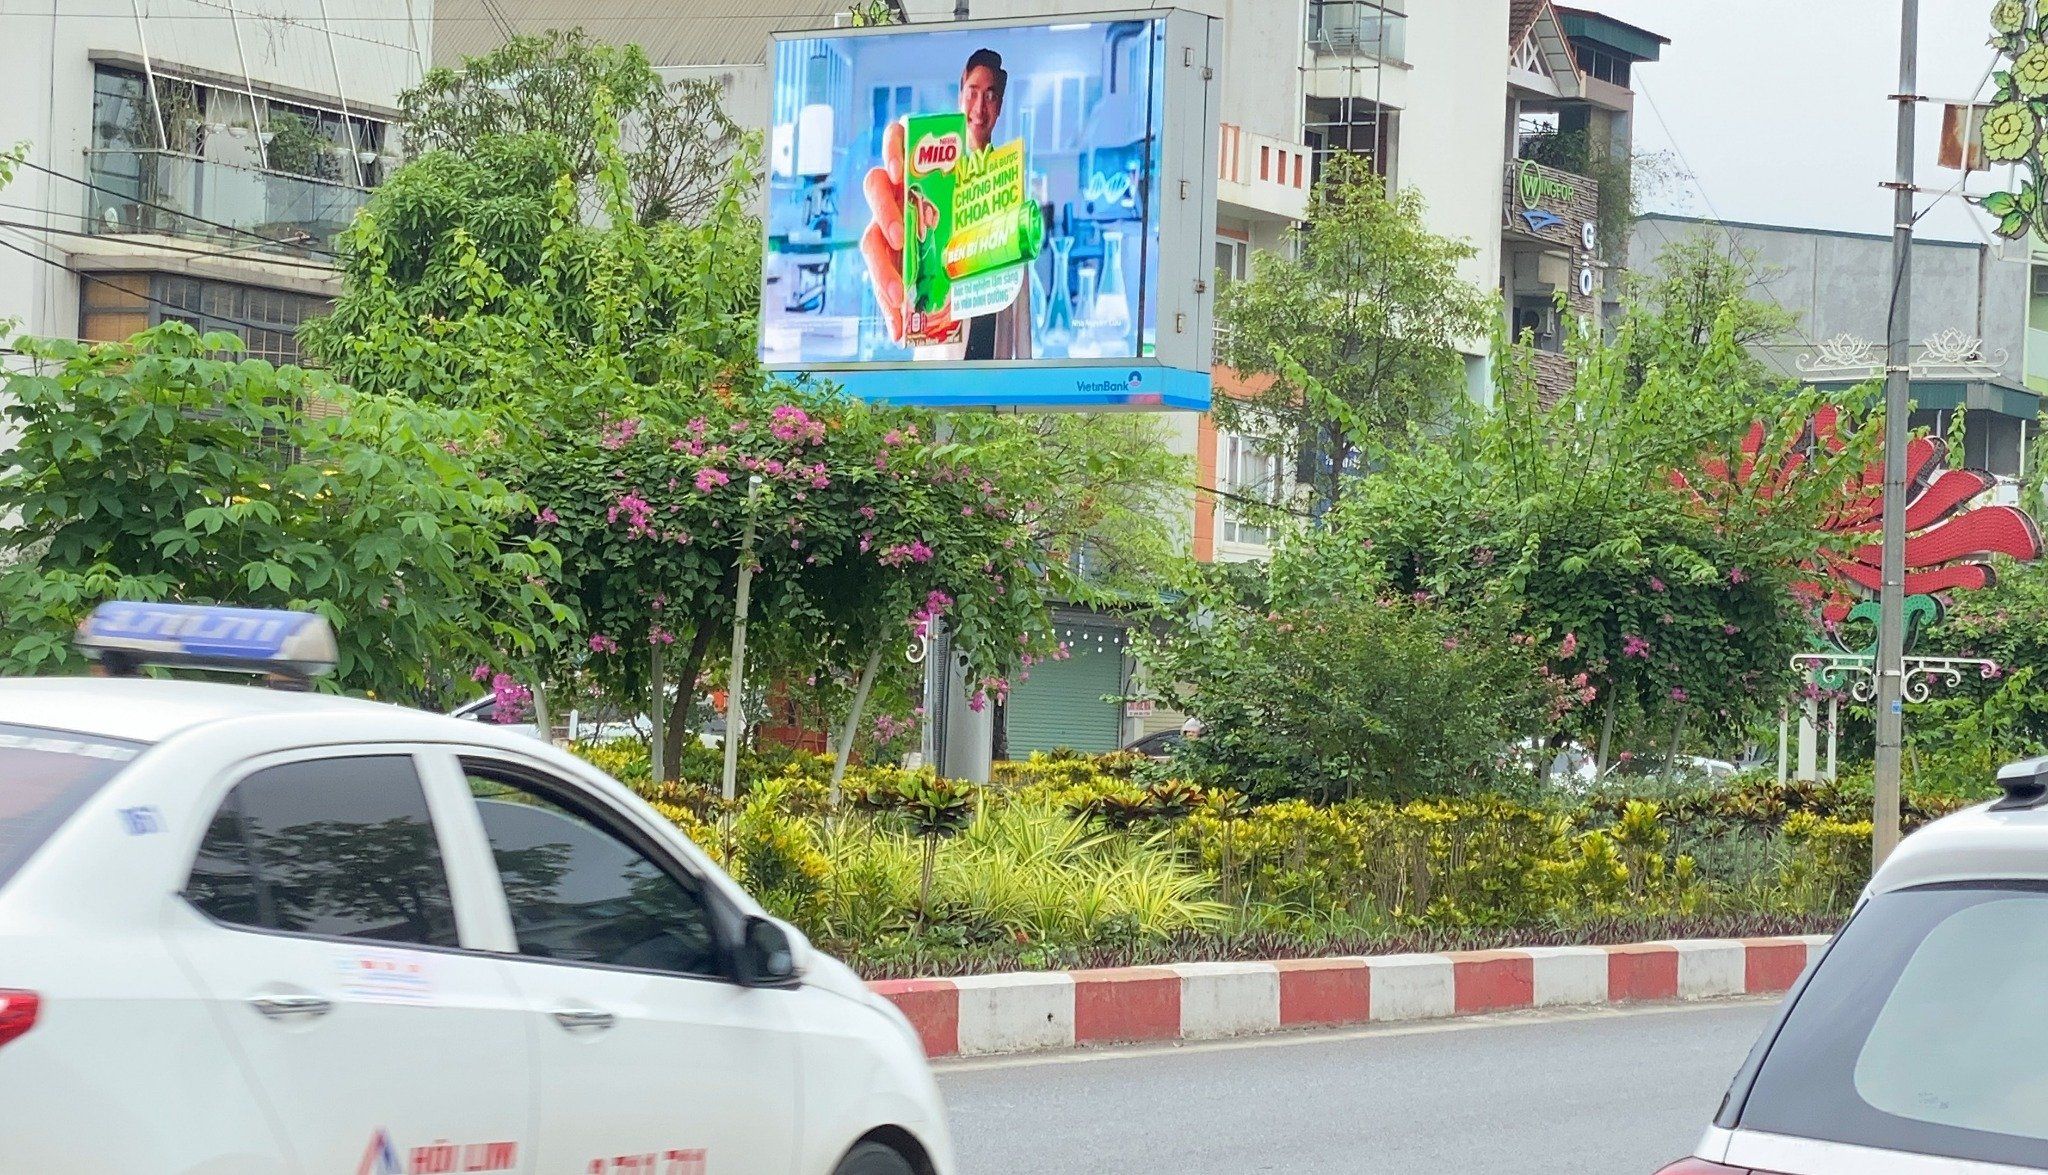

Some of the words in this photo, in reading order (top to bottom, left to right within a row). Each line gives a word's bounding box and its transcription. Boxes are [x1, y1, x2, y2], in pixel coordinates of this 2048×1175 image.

[918, 145, 957, 166] MILO
[955, 143, 994, 187] NAY
[955, 180, 992, 209] CHỨNG
[993, 165, 1019, 191] MINH
[1522, 174, 1574, 201] WINGFOR
[955, 199, 991, 231] KHOA
[992, 185, 1019, 213] HỌC
[1077, 380, 1129, 392] VietinBank
